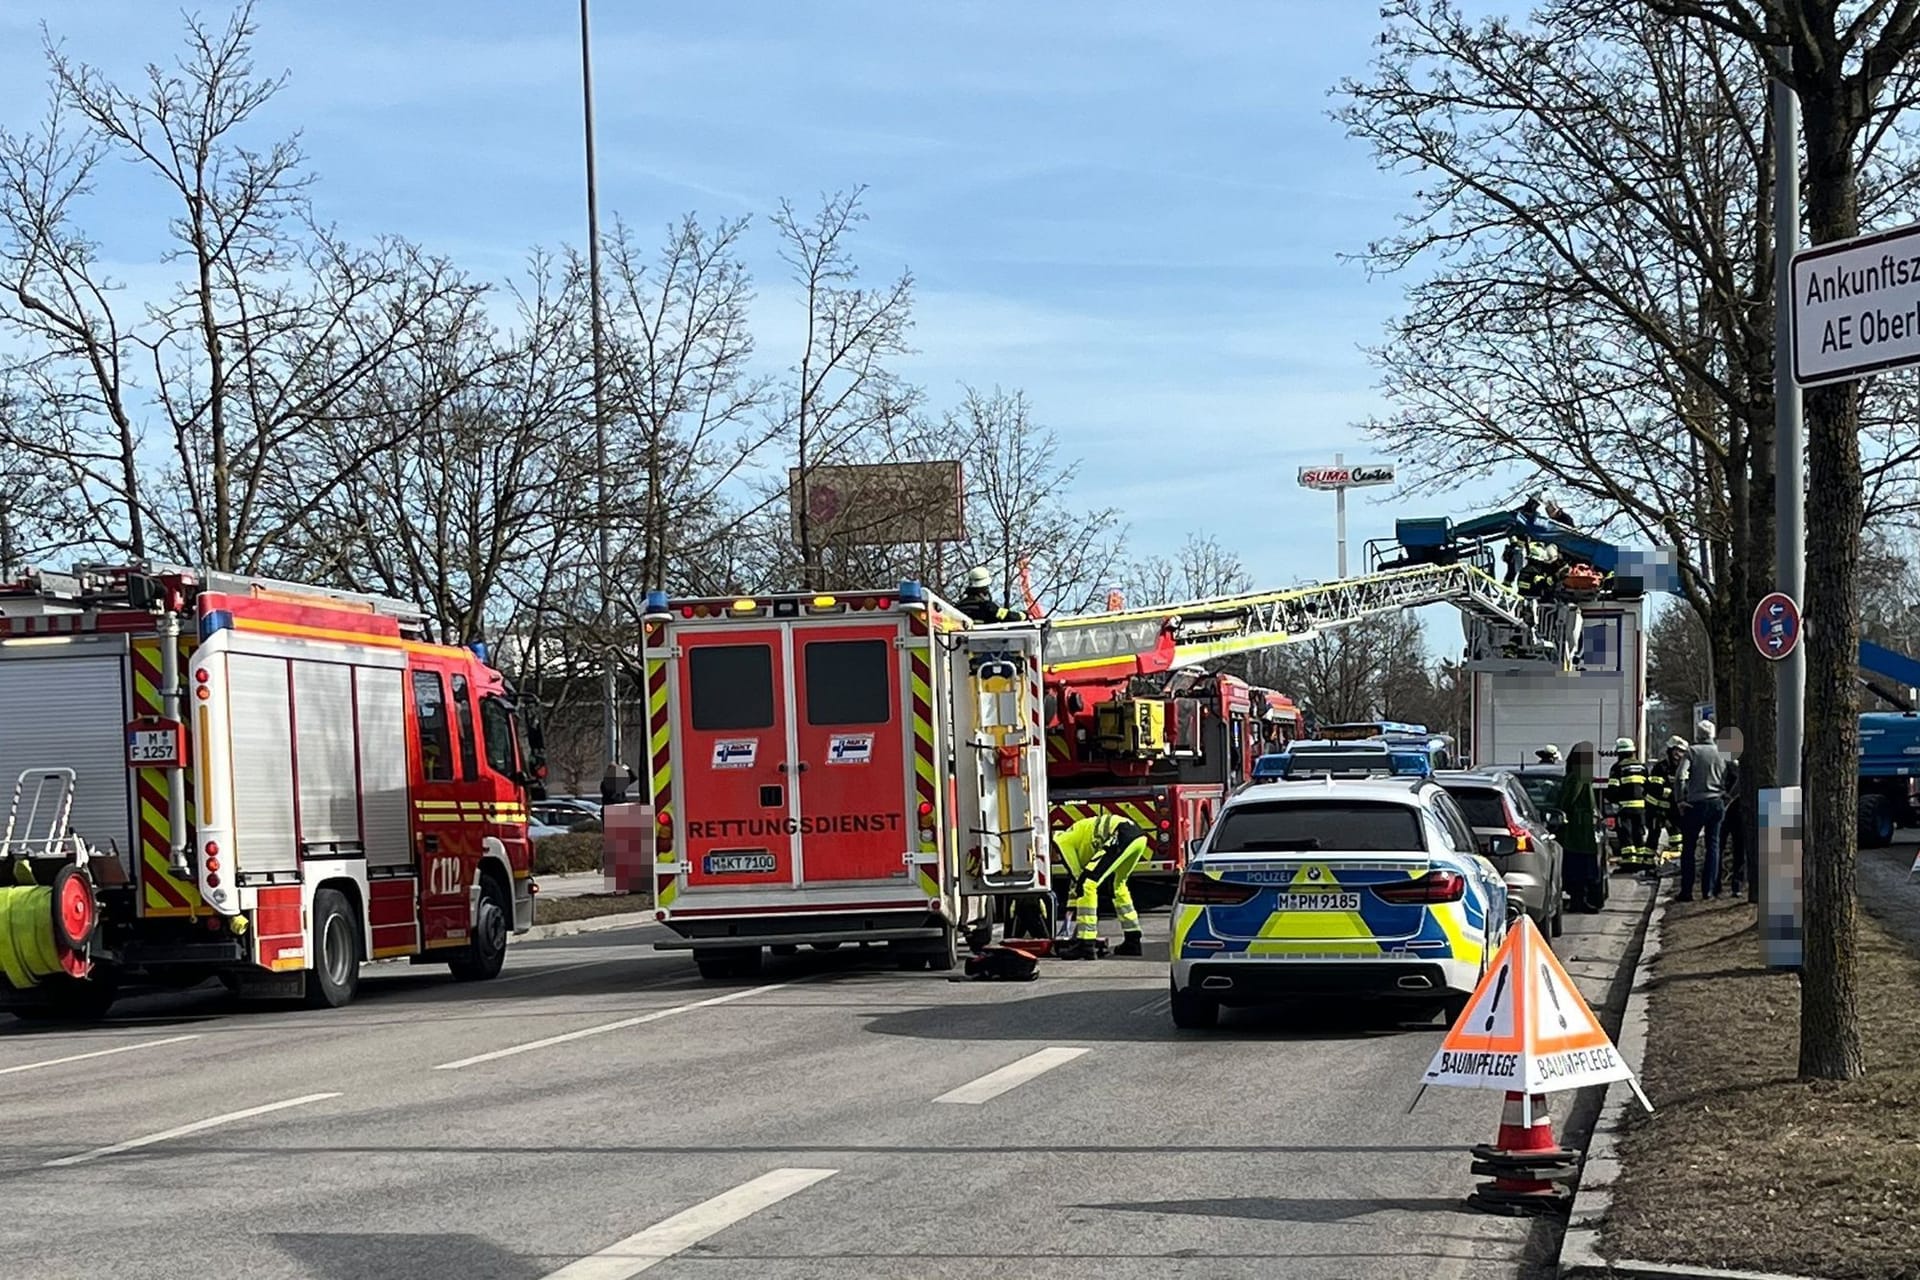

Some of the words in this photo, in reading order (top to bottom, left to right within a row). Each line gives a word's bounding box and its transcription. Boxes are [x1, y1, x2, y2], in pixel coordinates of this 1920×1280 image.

[1806, 255, 1920, 306] Ankunftsz
[1821, 315, 1853, 354] AE
[1860, 300, 1920, 346] Ober
[1304, 470, 1349, 482] SUMA
[1352, 467, 1394, 482] Center
[148, 732, 158, 745] M
[132, 746, 140, 759] F
[143, 745, 173, 759] 1257
[688, 813, 901, 838] RETTUNGSDIENST
[744, 855, 775, 869] 7100
[1246, 871, 1291, 882] POLIZEI
[1320, 894, 1358, 909] 9185
[1440, 1052, 1518, 1077] BAUMPFLEGE
[1536, 1048, 1616, 1080] BAUMPFLEGE
